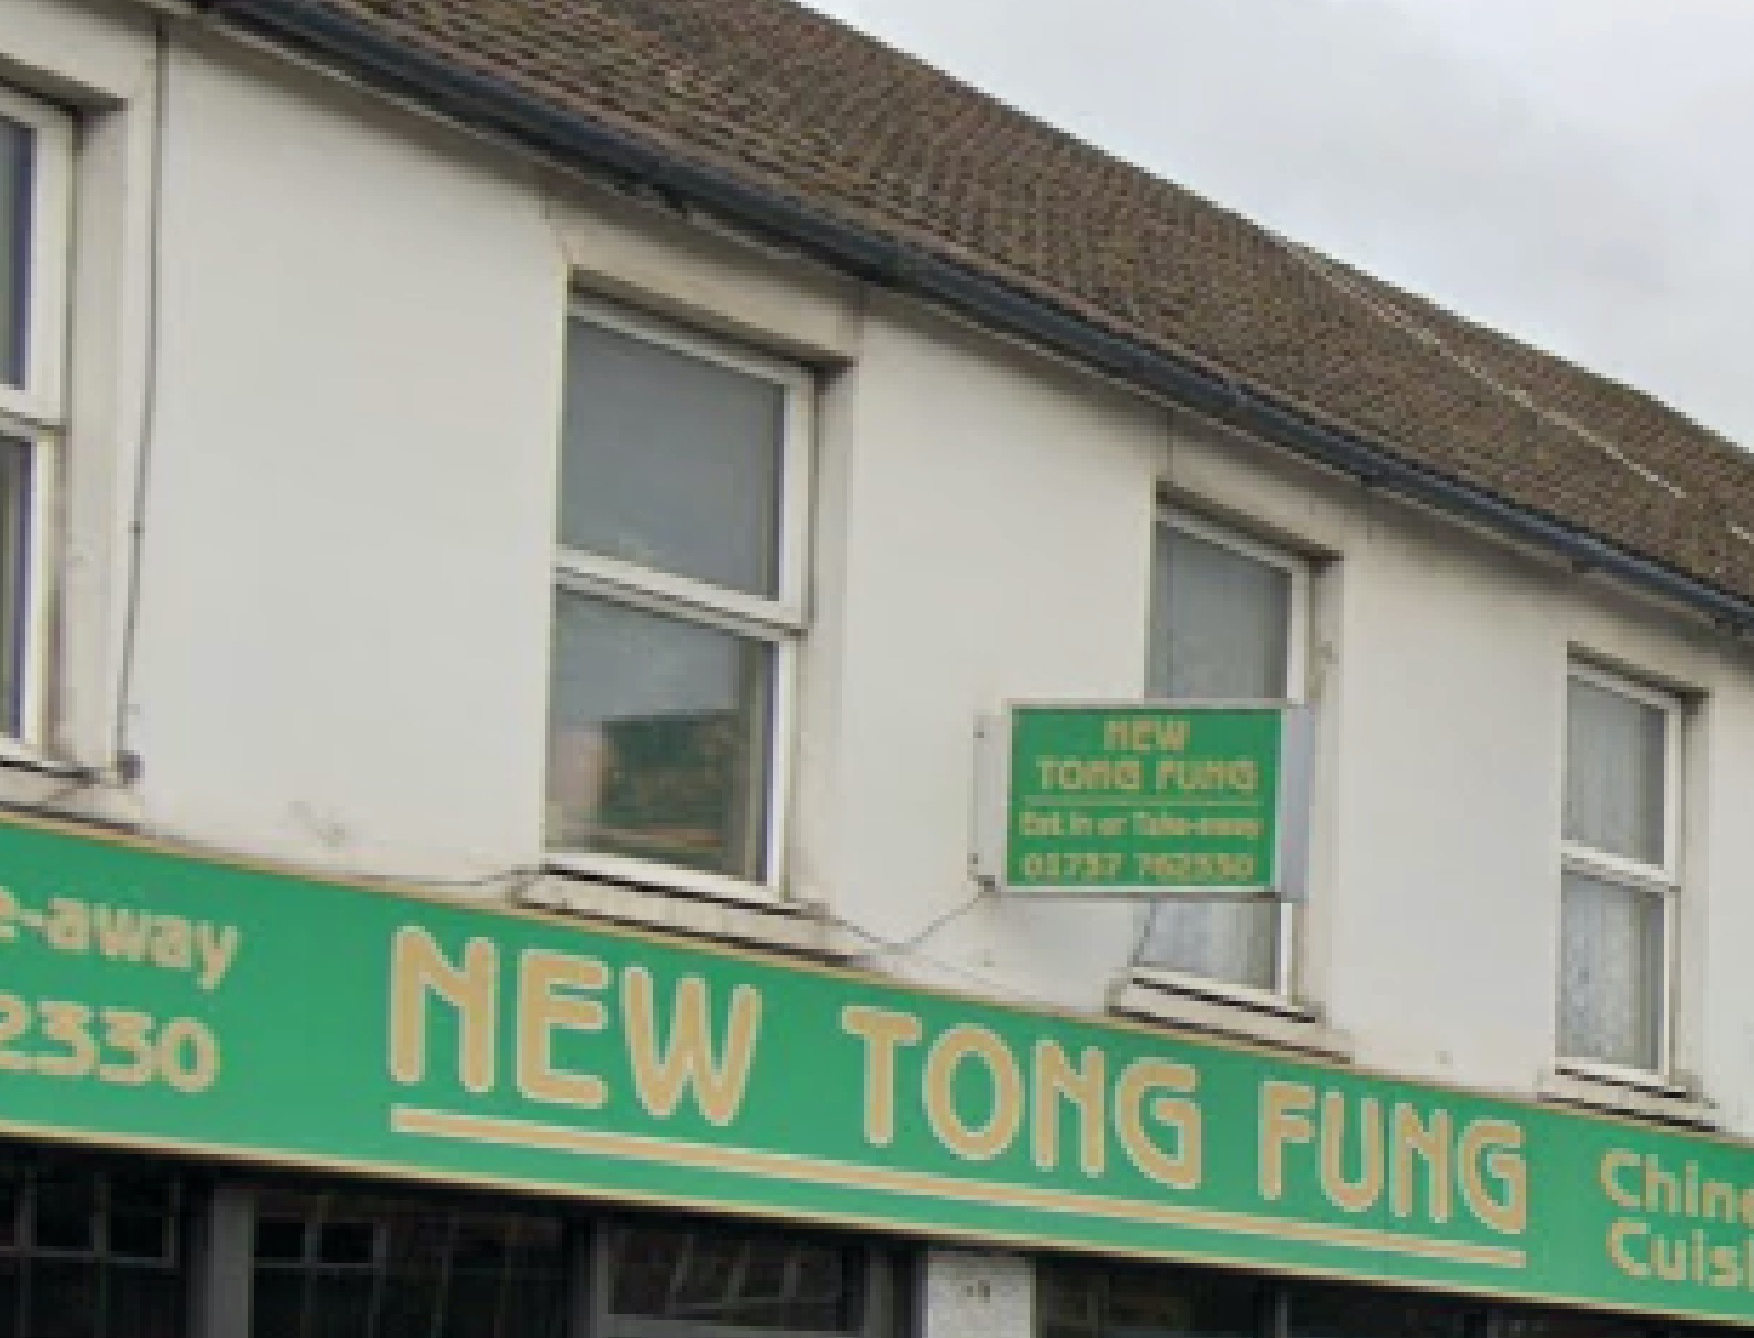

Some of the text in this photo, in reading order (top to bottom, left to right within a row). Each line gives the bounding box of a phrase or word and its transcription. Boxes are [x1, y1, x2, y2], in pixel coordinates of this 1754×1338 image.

[1103, 720, 1190, 752] NEW
[1036, 757, 1260, 793] TONG FUNG
[390, 924, 1529, 1236] NEW TONG FUNG
